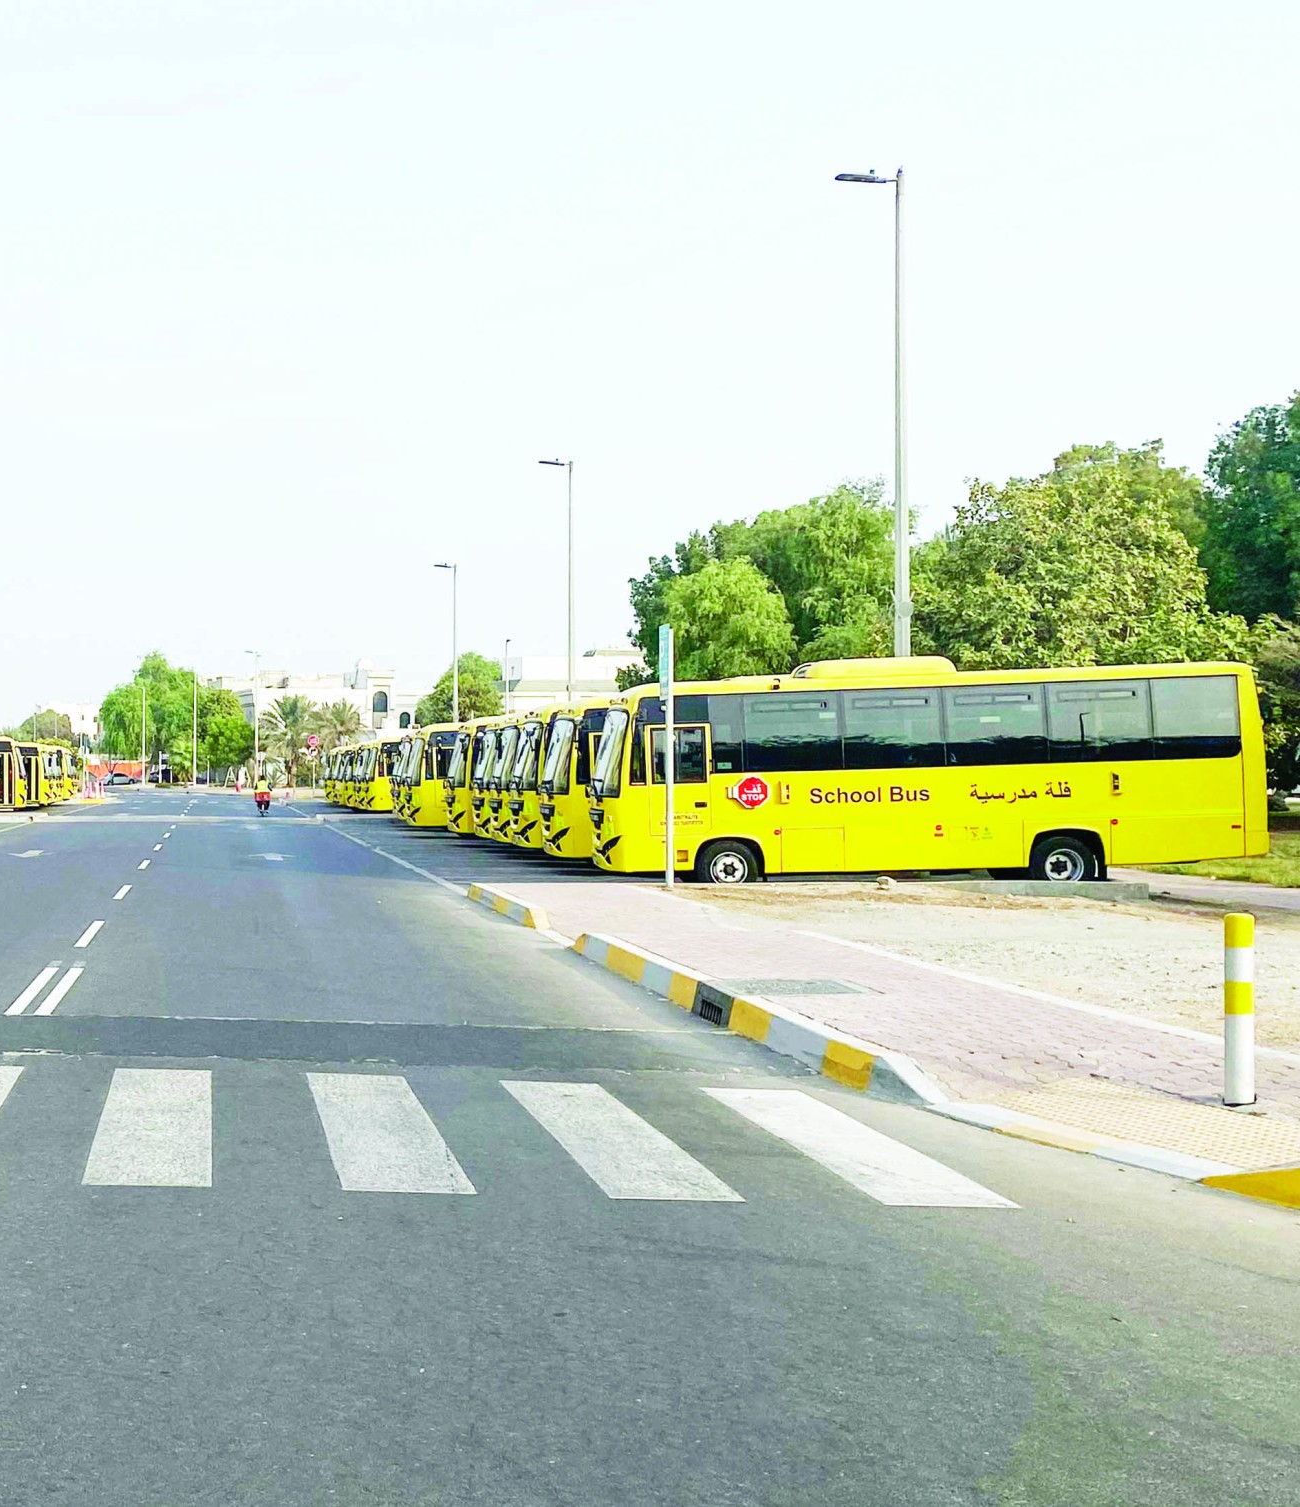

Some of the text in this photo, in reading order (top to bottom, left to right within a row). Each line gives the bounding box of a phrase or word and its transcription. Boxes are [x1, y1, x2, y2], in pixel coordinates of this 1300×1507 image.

[741, 793, 766, 801] STOP
[809, 786, 930, 804] School Bus
[969, 781, 1072, 804] فلة مدرسية
